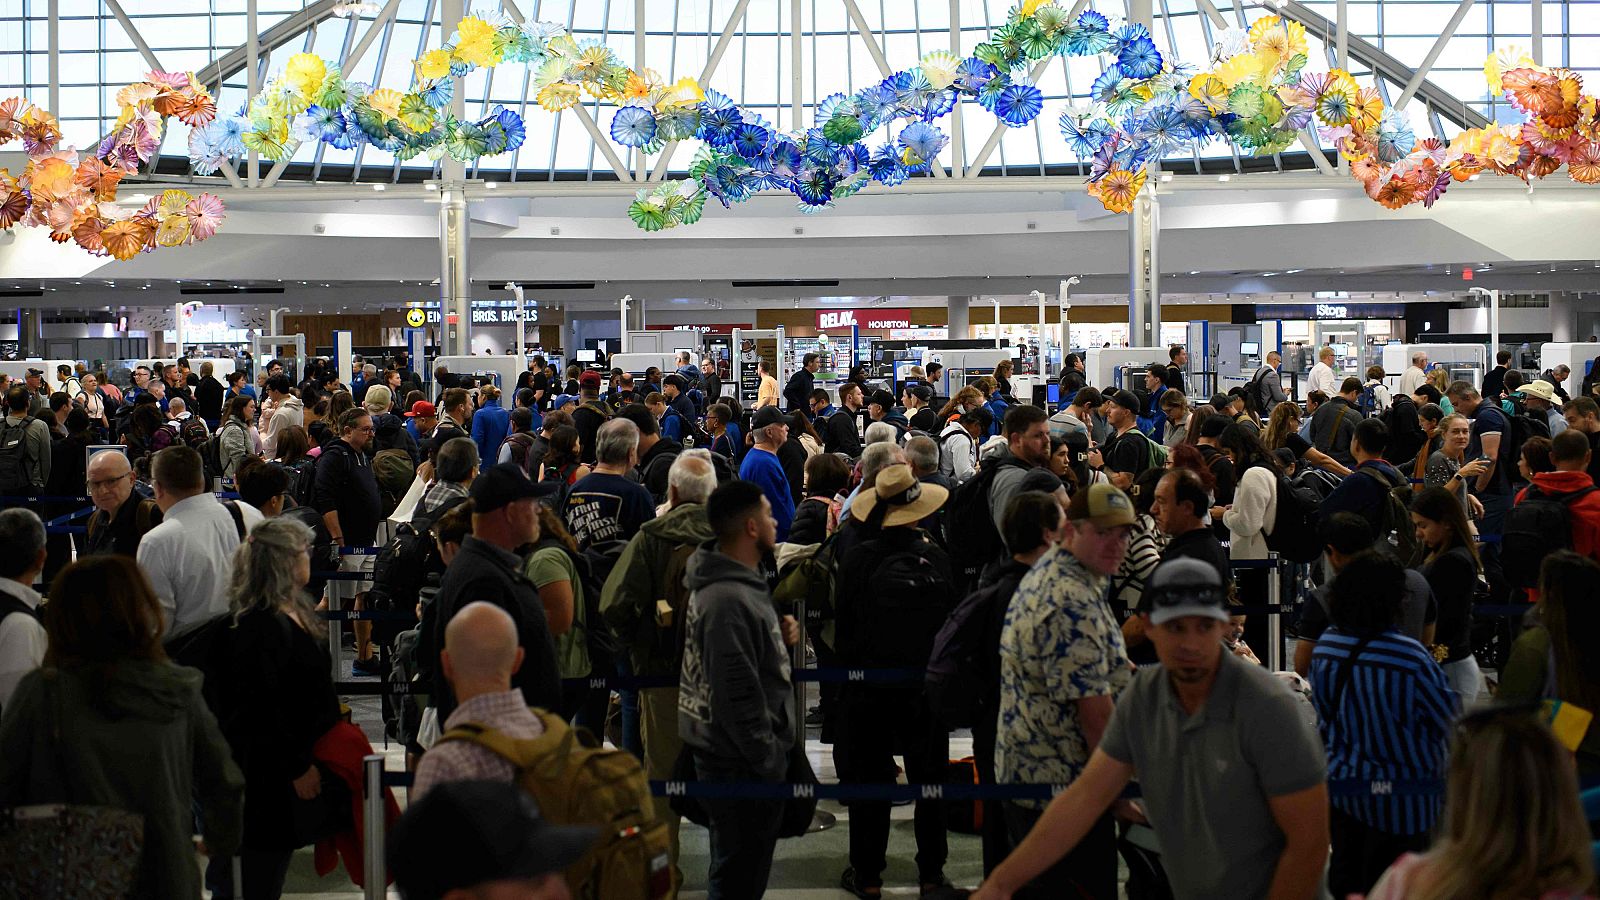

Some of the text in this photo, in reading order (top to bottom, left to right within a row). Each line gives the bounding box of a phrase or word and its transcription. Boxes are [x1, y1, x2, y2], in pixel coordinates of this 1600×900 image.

[472, 310, 498, 322] BROS.
[1316, 304, 1347, 317] iStore
[701, 326, 711, 334] go
[868, 320, 909, 329] HOUSTON
[353, 547, 365, 555] IAH
[963, 567, 976, 575] IAH
[347, 610, 360, 620] IAH
[807, 609, 821, 618] IAH
[848, 669, 865, 681] IAH
[393, 683, 409, 693] IAH
[590, 677, 606, 689] IAH
[665, 781, 687, 796] IAH
[793, 783, 815, 798] IAH
[921, 784, 943, 799] IAH
[1371, 780, 1393, 795] IAH
